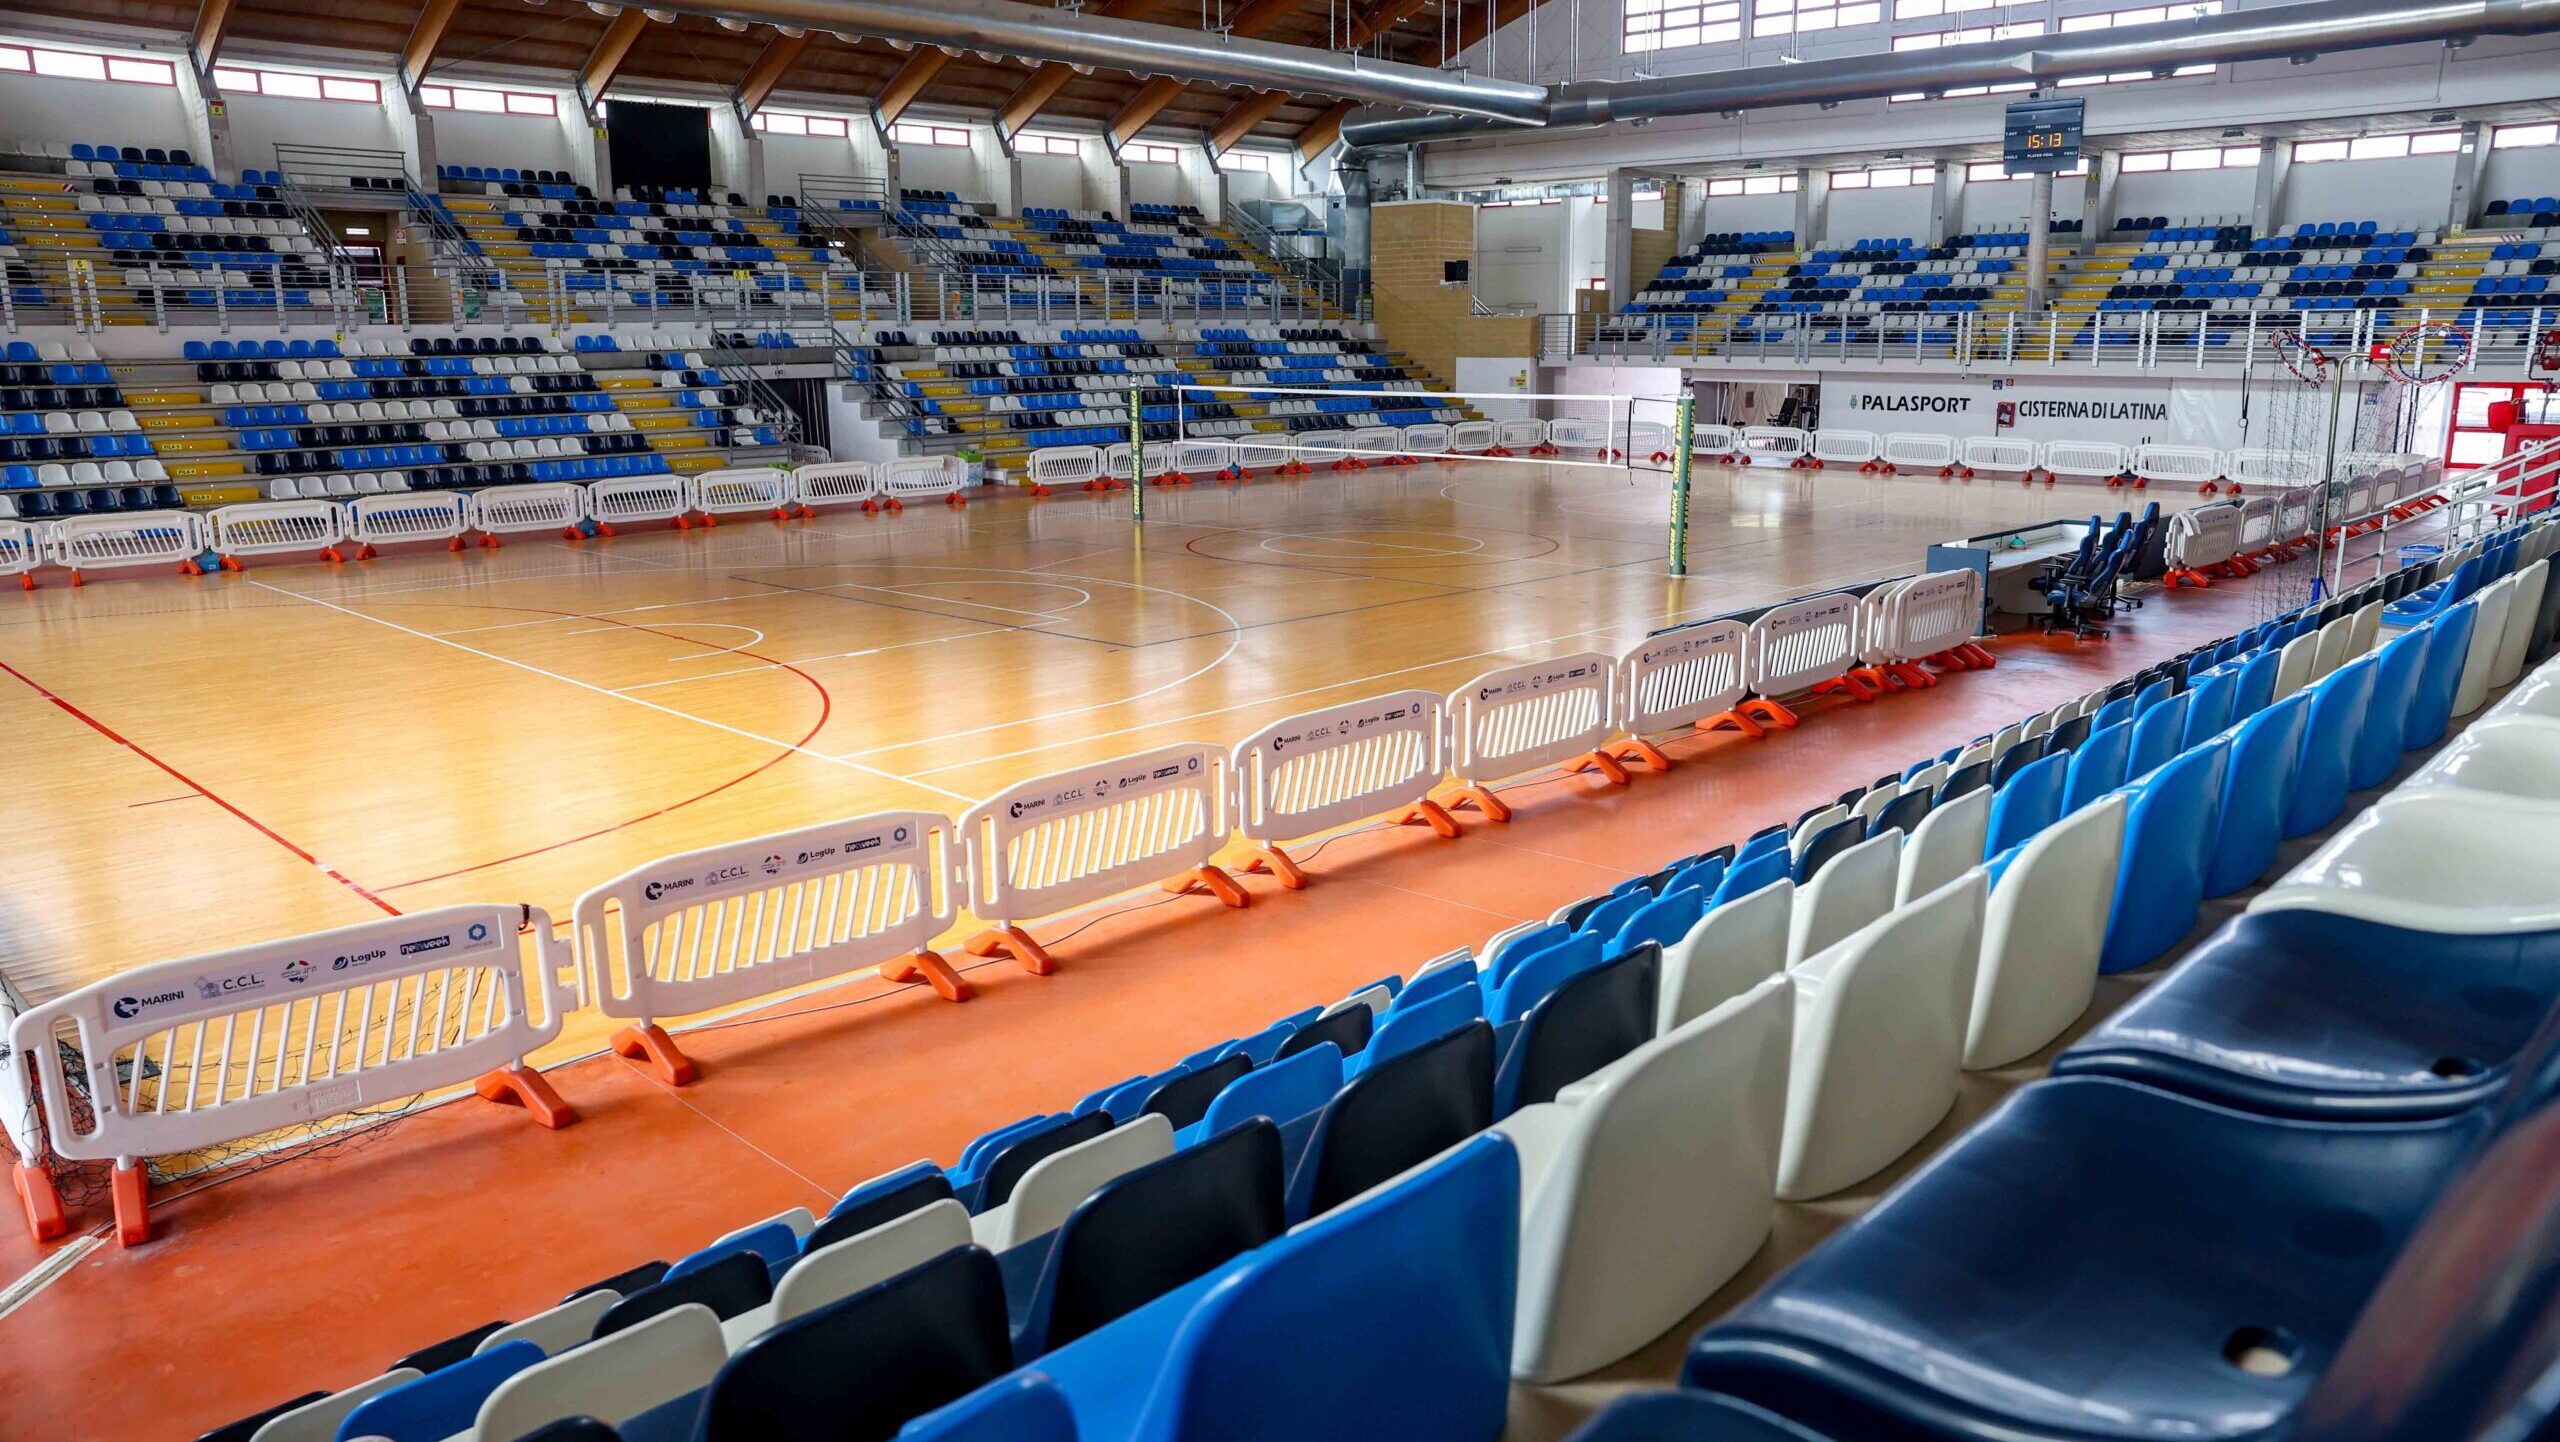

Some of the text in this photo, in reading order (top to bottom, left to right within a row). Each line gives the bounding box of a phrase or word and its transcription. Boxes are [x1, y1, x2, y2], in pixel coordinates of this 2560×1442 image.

[2027, 132, 2063, 149] 15:13
[1861, 395, 1971, 413] PALASPORT
[2019, 400, 2168, 420] CISTERNA DI LATINA
[1127, 774, 1147, 784] LogUp
[1063, 789, 1086, 800] C.C.L.
[1023, 799, 1045, 810] MARINI
[810, 847, 836, 859] LogUp
[719, 866, 750, 879] C.C.L.
[664, 878, 694, 891] MARINI
[350, 949, 386, 963] LogUp
[222, 974, 265, 990] C.C.L.
[141, 990, 184, 1007] MARINI
